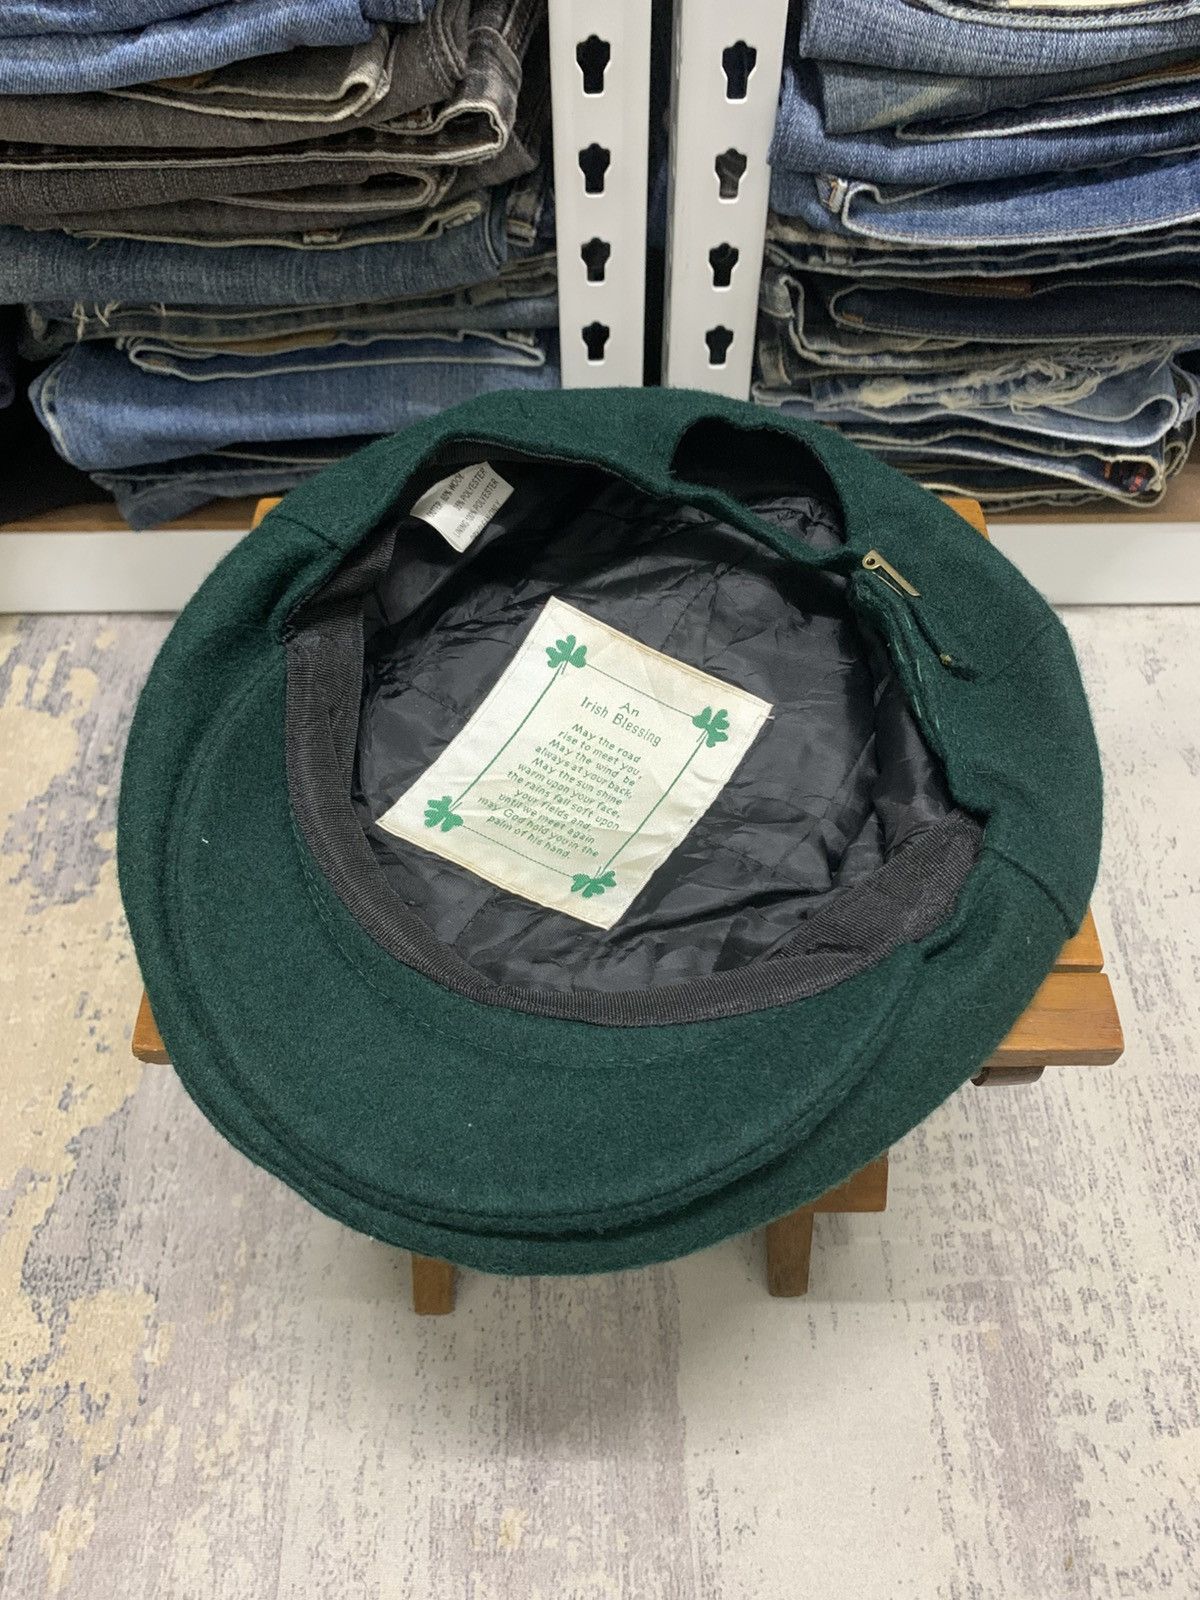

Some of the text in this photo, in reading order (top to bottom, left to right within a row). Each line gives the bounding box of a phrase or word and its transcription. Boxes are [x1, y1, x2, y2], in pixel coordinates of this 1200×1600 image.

[580, 696, 662, 748] Irish Blessing
[619, 702, 640, 716] An
[548, 738, 636, 787] May the wind be
[557, 730, 578, 745] rise
[580, 740, 592, 751] to
[592, 748, 619, 765] meet
[571, 723, 642, 764] May the road
[518, 763, 546, 781] warm
[546, 778, 570, 794] upon
[570, 790, 596, 805] your
[531, 757, 623, 806] May the sun shine
[534, 745, 570, 768] always
[570, 764, 584, 774] at
[582, 769, 608, 785] your
[498, 793, 595, 844] until we meet again
[507, 770, 620, 830] the rains fall soft upon
[514, 789, 539, 804] your
[540, 801, 569, 820] fields
[477, 796, 501, 812] may
[503, 808, 527, 824] God
[526, 820, 550, 835] hold
[581, 846, 599, 858] the
[485, 816, 513, 831] palm
[513, 828, 528, 837] of
[526, 833, 544, 846] his
